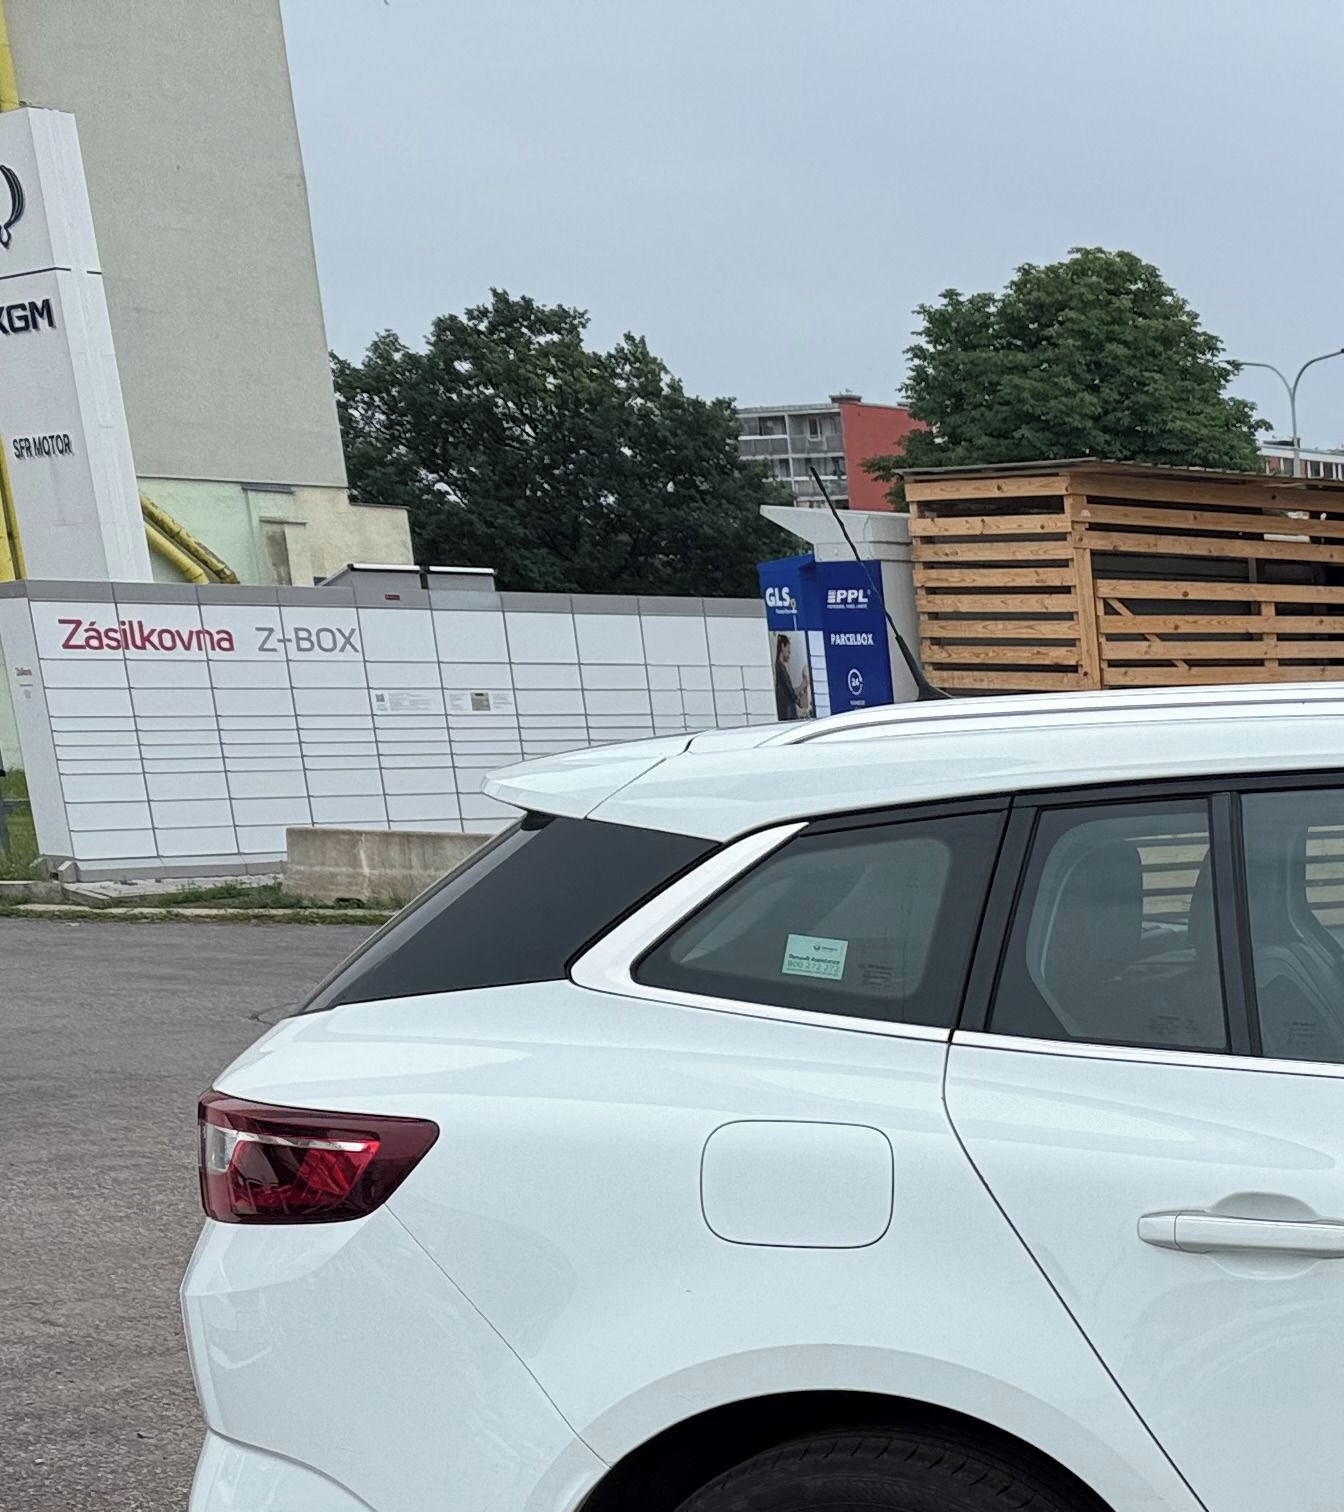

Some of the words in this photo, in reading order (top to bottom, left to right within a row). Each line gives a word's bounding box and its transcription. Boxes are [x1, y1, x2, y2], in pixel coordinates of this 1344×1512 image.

[13, 438, 32, 459] SFR
[32, 434, 73, 457] MOTOR
[765, 586, 790, 607] GLS
[836, 589, 869, 603] PPL
[57, 618, 235, 652] Zásilkovna
[254, 626, 360, 653] Z-BOX
[830, 633, 874, 646] PARCELBOX
